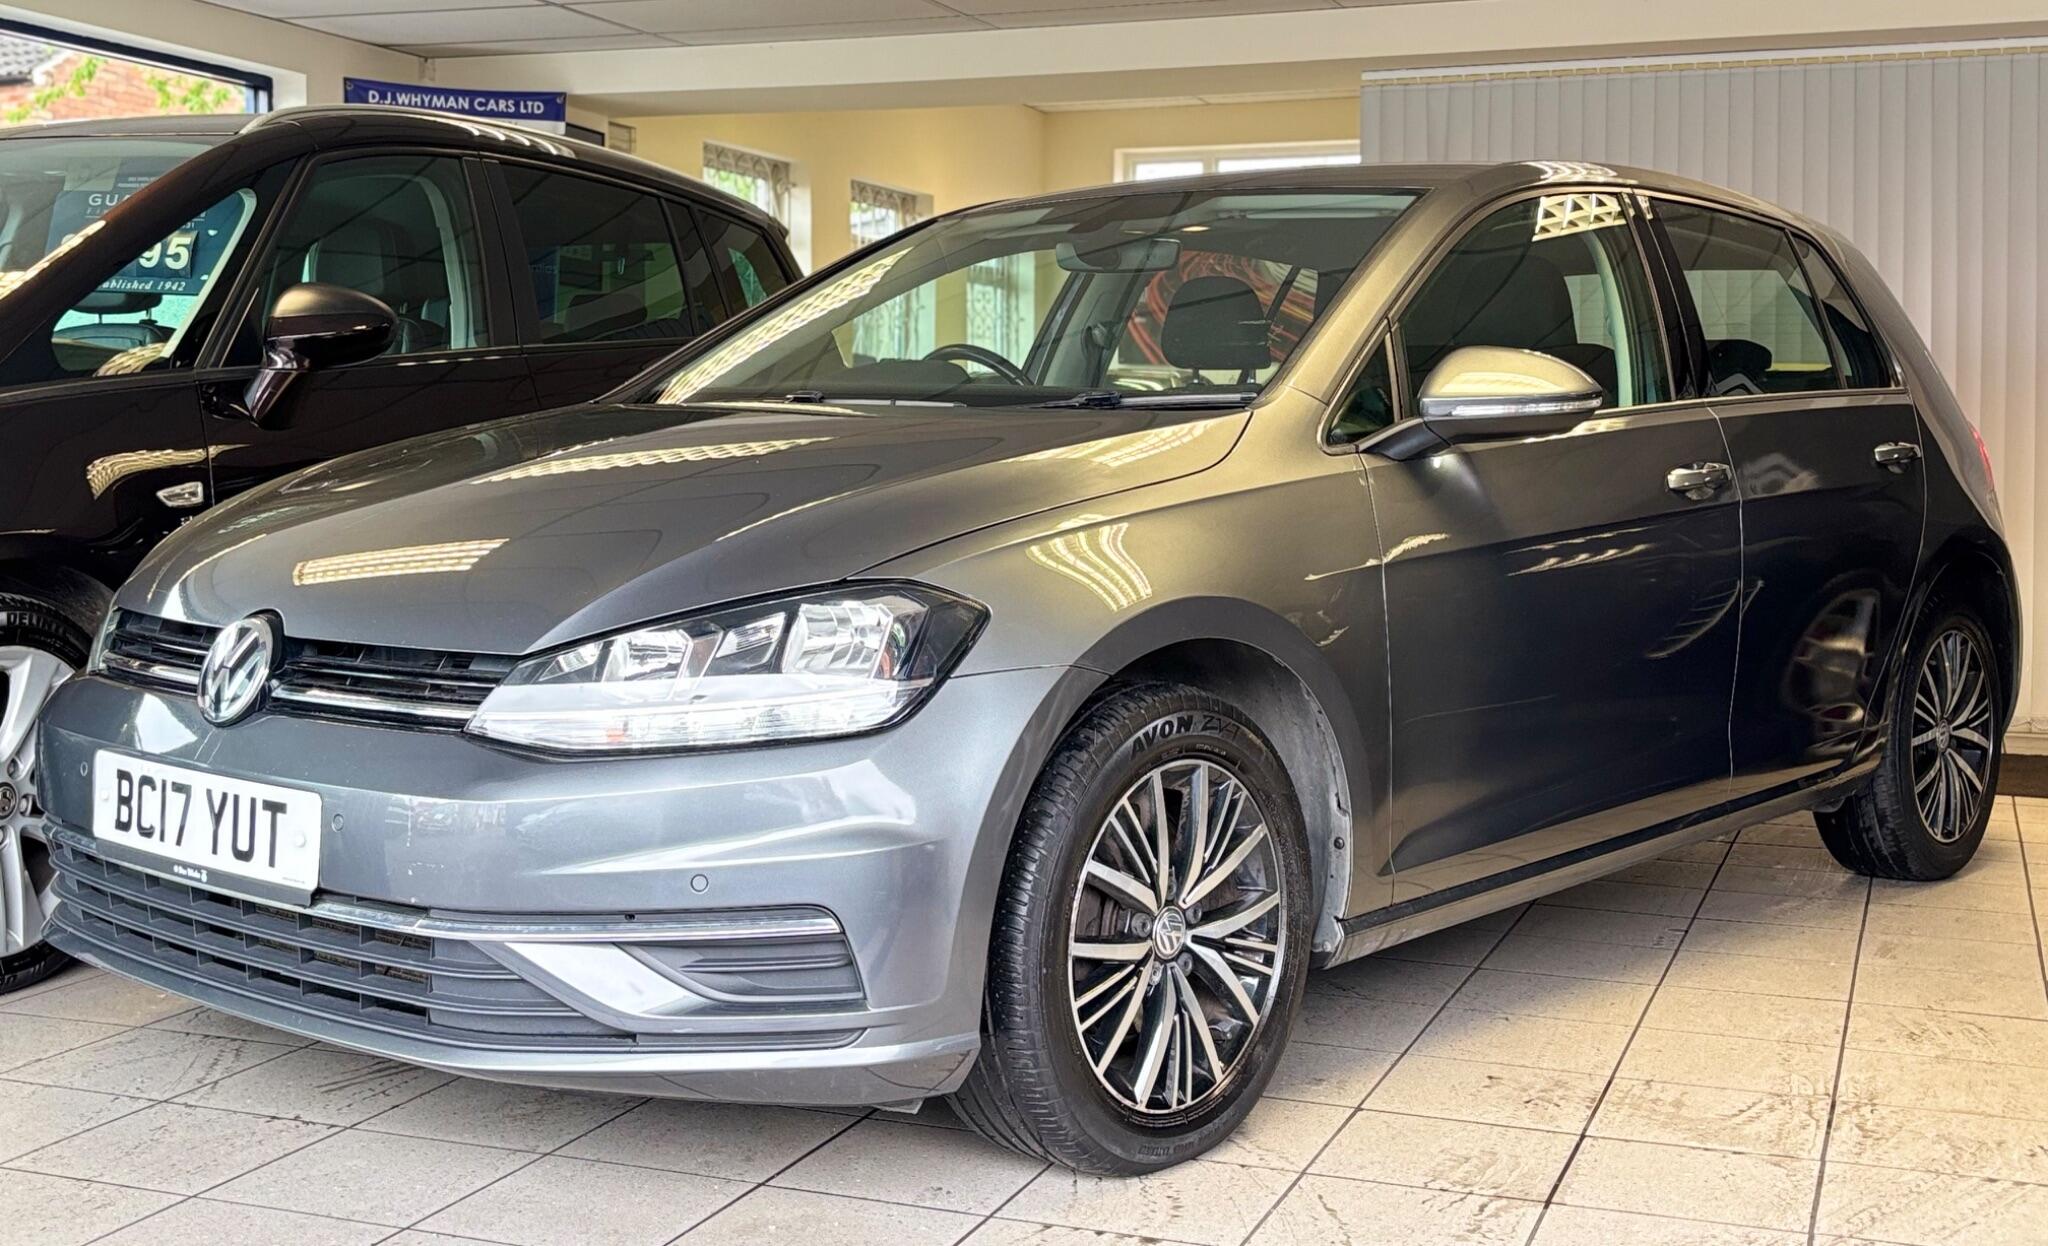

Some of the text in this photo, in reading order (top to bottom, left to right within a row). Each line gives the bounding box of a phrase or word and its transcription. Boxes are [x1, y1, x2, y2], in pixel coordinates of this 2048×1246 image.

[474, 98, 515, 113] CARS
[520, 101, 544, 114] LTD
[157, 281, 186, 291] 1942
[1130, 714, 1194, 759] AVON
[115, 769, 287, 868] BC17 YUT
